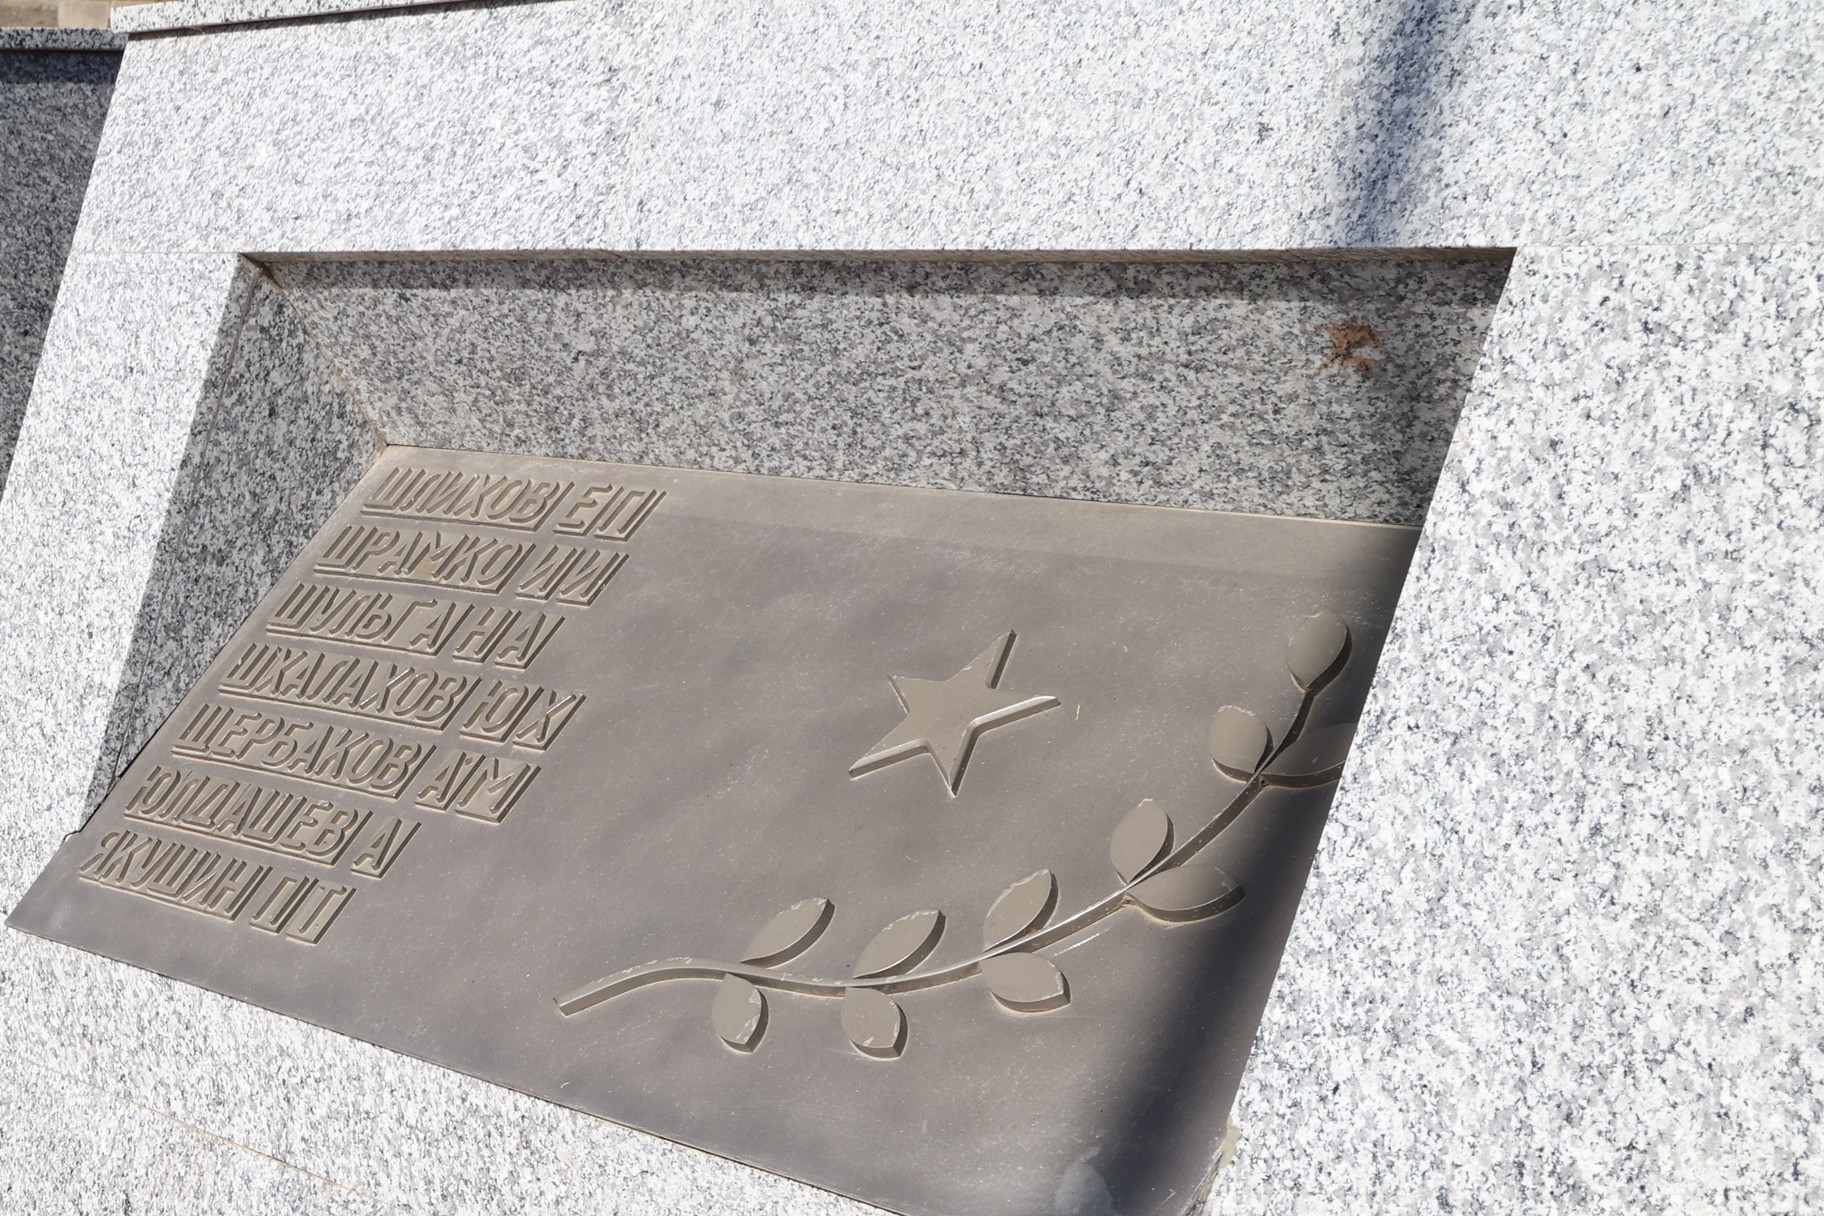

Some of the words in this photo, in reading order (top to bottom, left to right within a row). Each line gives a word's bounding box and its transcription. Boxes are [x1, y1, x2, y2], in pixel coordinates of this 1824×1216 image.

[361, 465, 566, 524] ШЛИХОВ
[313, 522, 529, 589] ШРАМКО
[265, 582, 459, 650] ШУЛЬГА
[216, 641, 472, 725] ШХАЛАХОВ
[171, 703, 426, 792] ЩЕРБАКОВ
[122, 765, 365, 858] ЮЛДАШЕВ
[74, 828, 270, 915] ЯКУШИН
